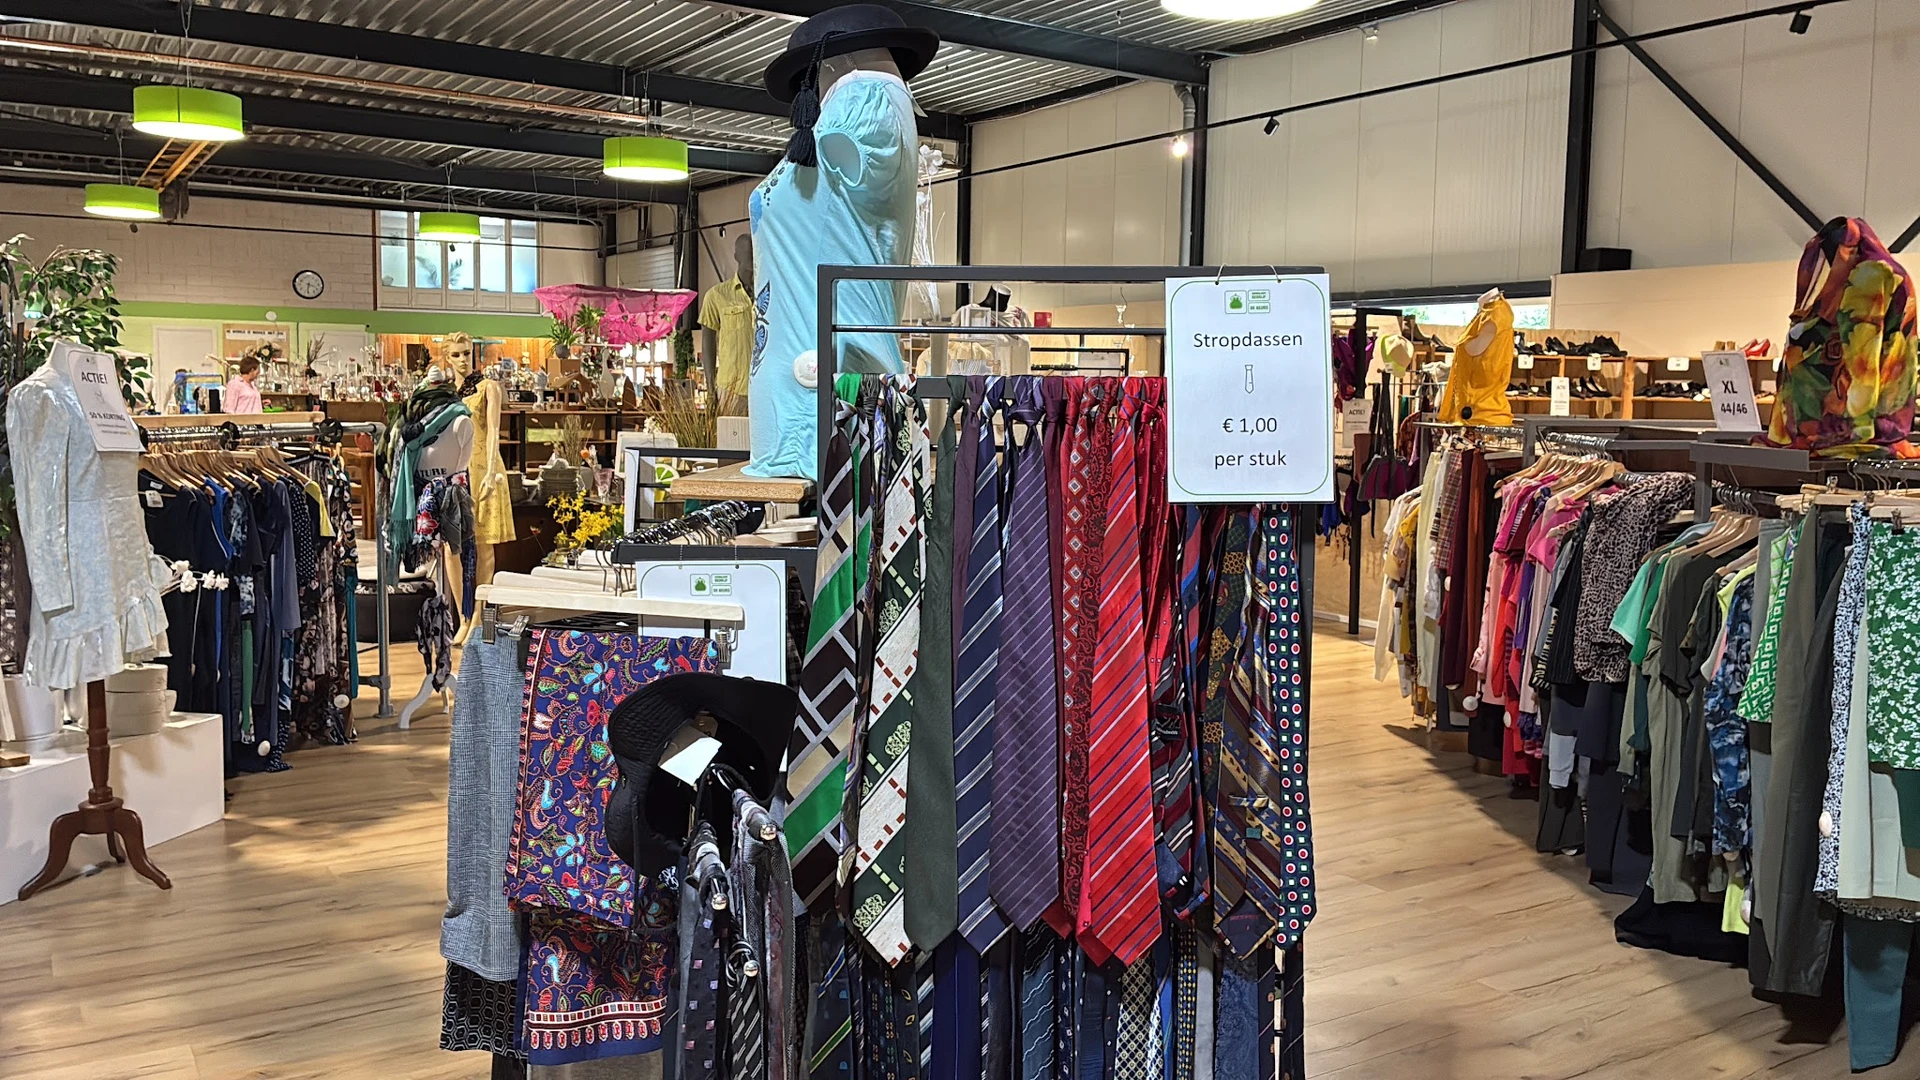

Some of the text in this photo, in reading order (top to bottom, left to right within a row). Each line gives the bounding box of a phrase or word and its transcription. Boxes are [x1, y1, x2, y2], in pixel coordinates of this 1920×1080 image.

[1193, 331, 1303, 351] Stropdassen
[81, 371, 108, 385] ACTIE!
[1721, 380, 1738, 394] XL
[1720, 402, 1748, 416] 44/46
[1222, 417, 1278, 435] € 1,00
[1214, 450, 1287, 470] per stuk
